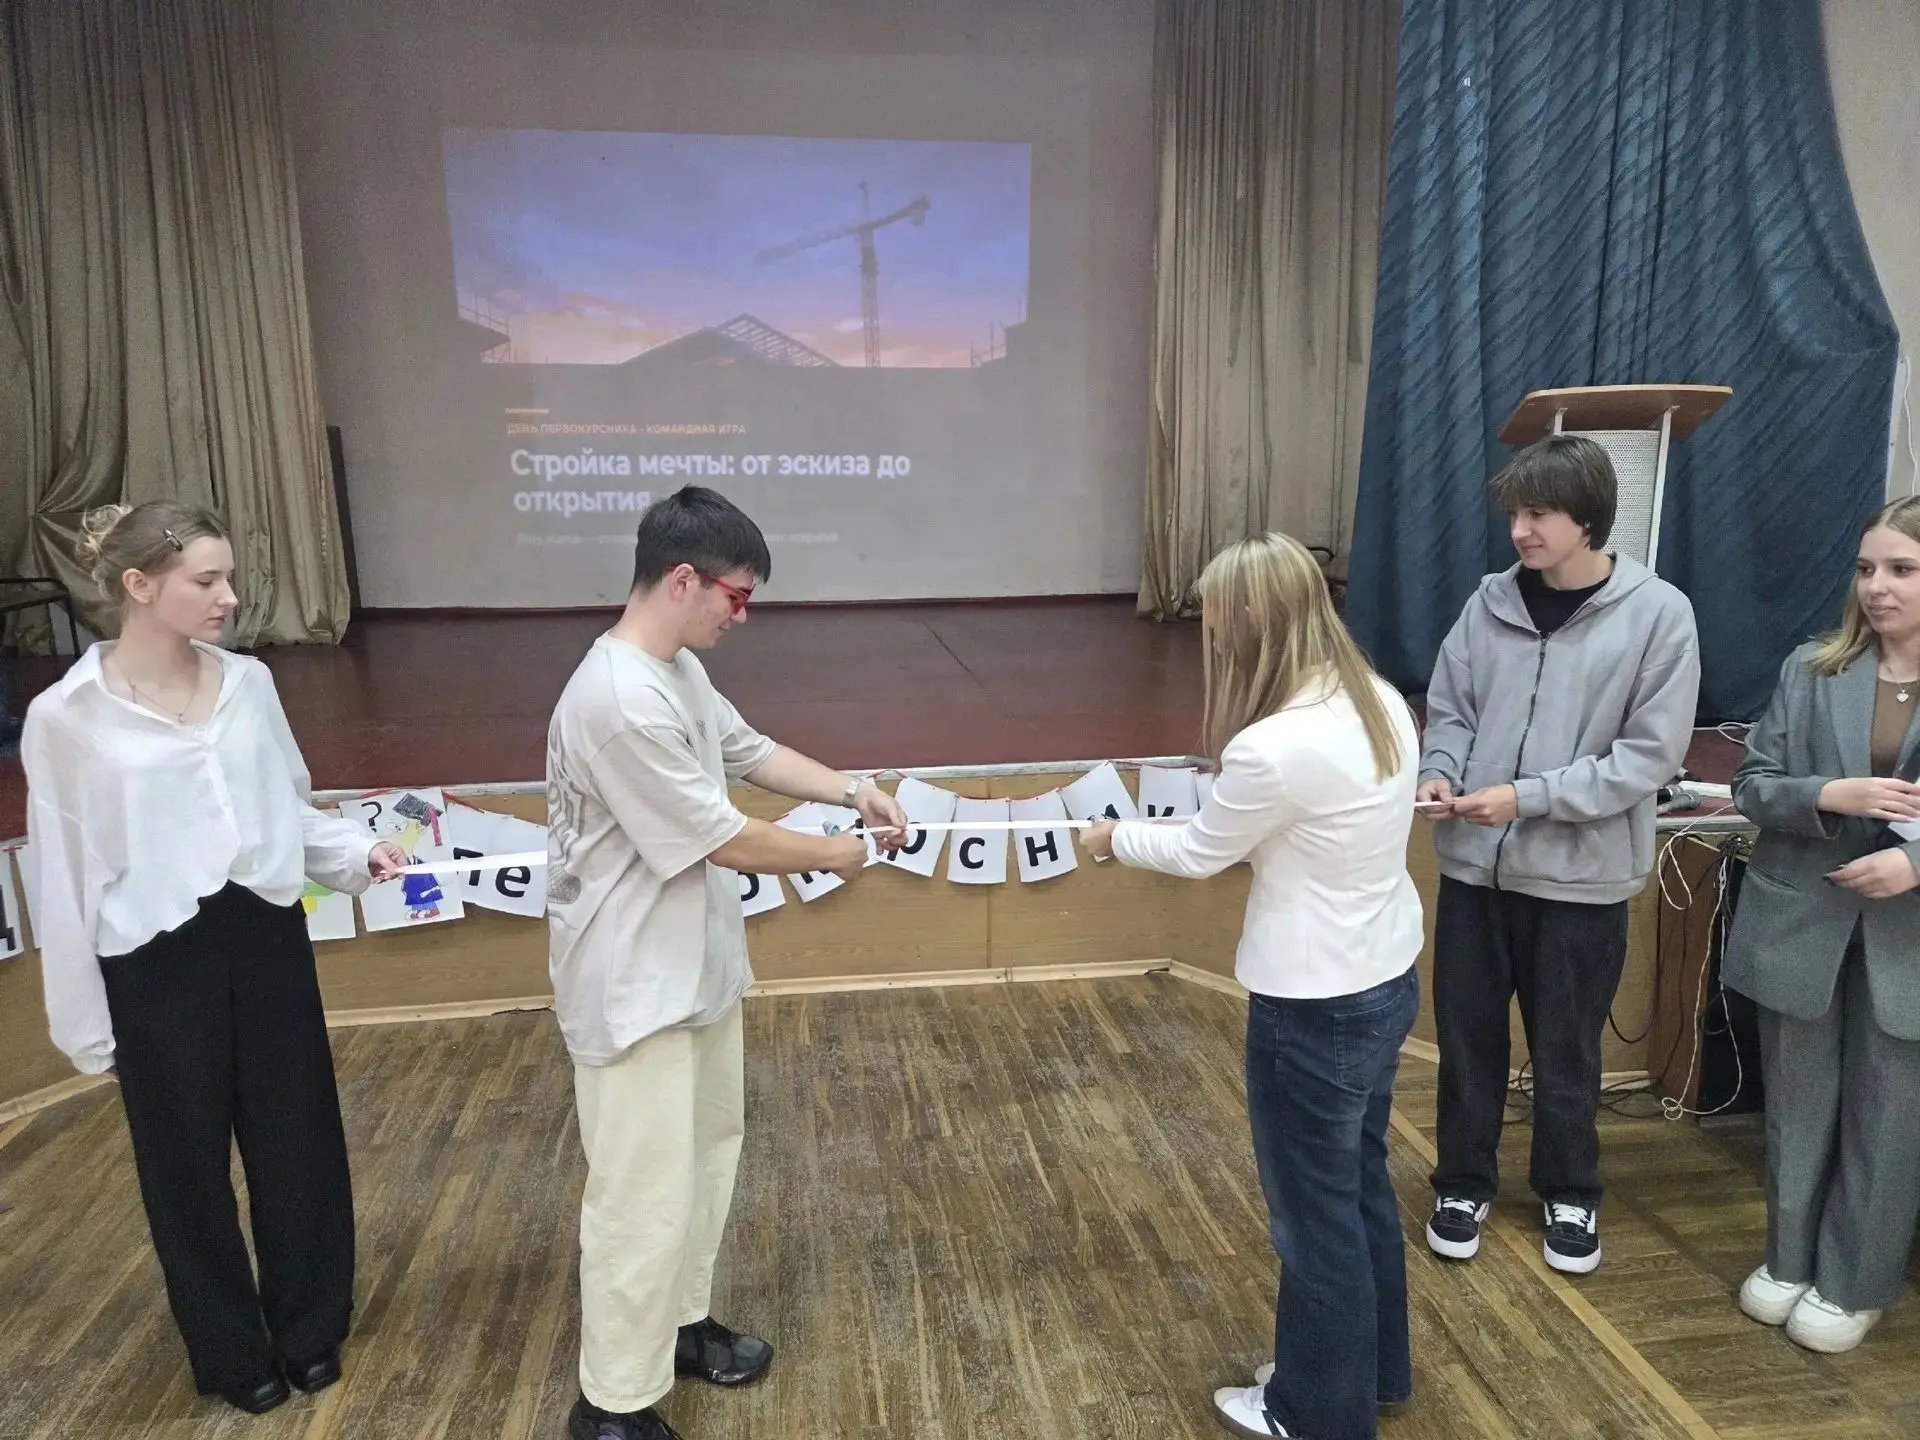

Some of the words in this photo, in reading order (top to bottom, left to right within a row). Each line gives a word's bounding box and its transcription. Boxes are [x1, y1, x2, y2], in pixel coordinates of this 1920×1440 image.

[506, 424, 537, 434] ДЕНЬ
[540, 424, 637, 434] ПЕРВОКУРСНИКА
[646, 424, 715, 435] КОМАНДНАЯ
[718, 424, 747, 434] ИГРА
[510, 448, 632, 481] Стройка
[640, 454, 735, 476] мечты:
[741, 454, 770, 475] от
[777, 453, 870, 475] эскиза
[876, 454, 911, 478] до
[513, 491, 651, 518] открытия
